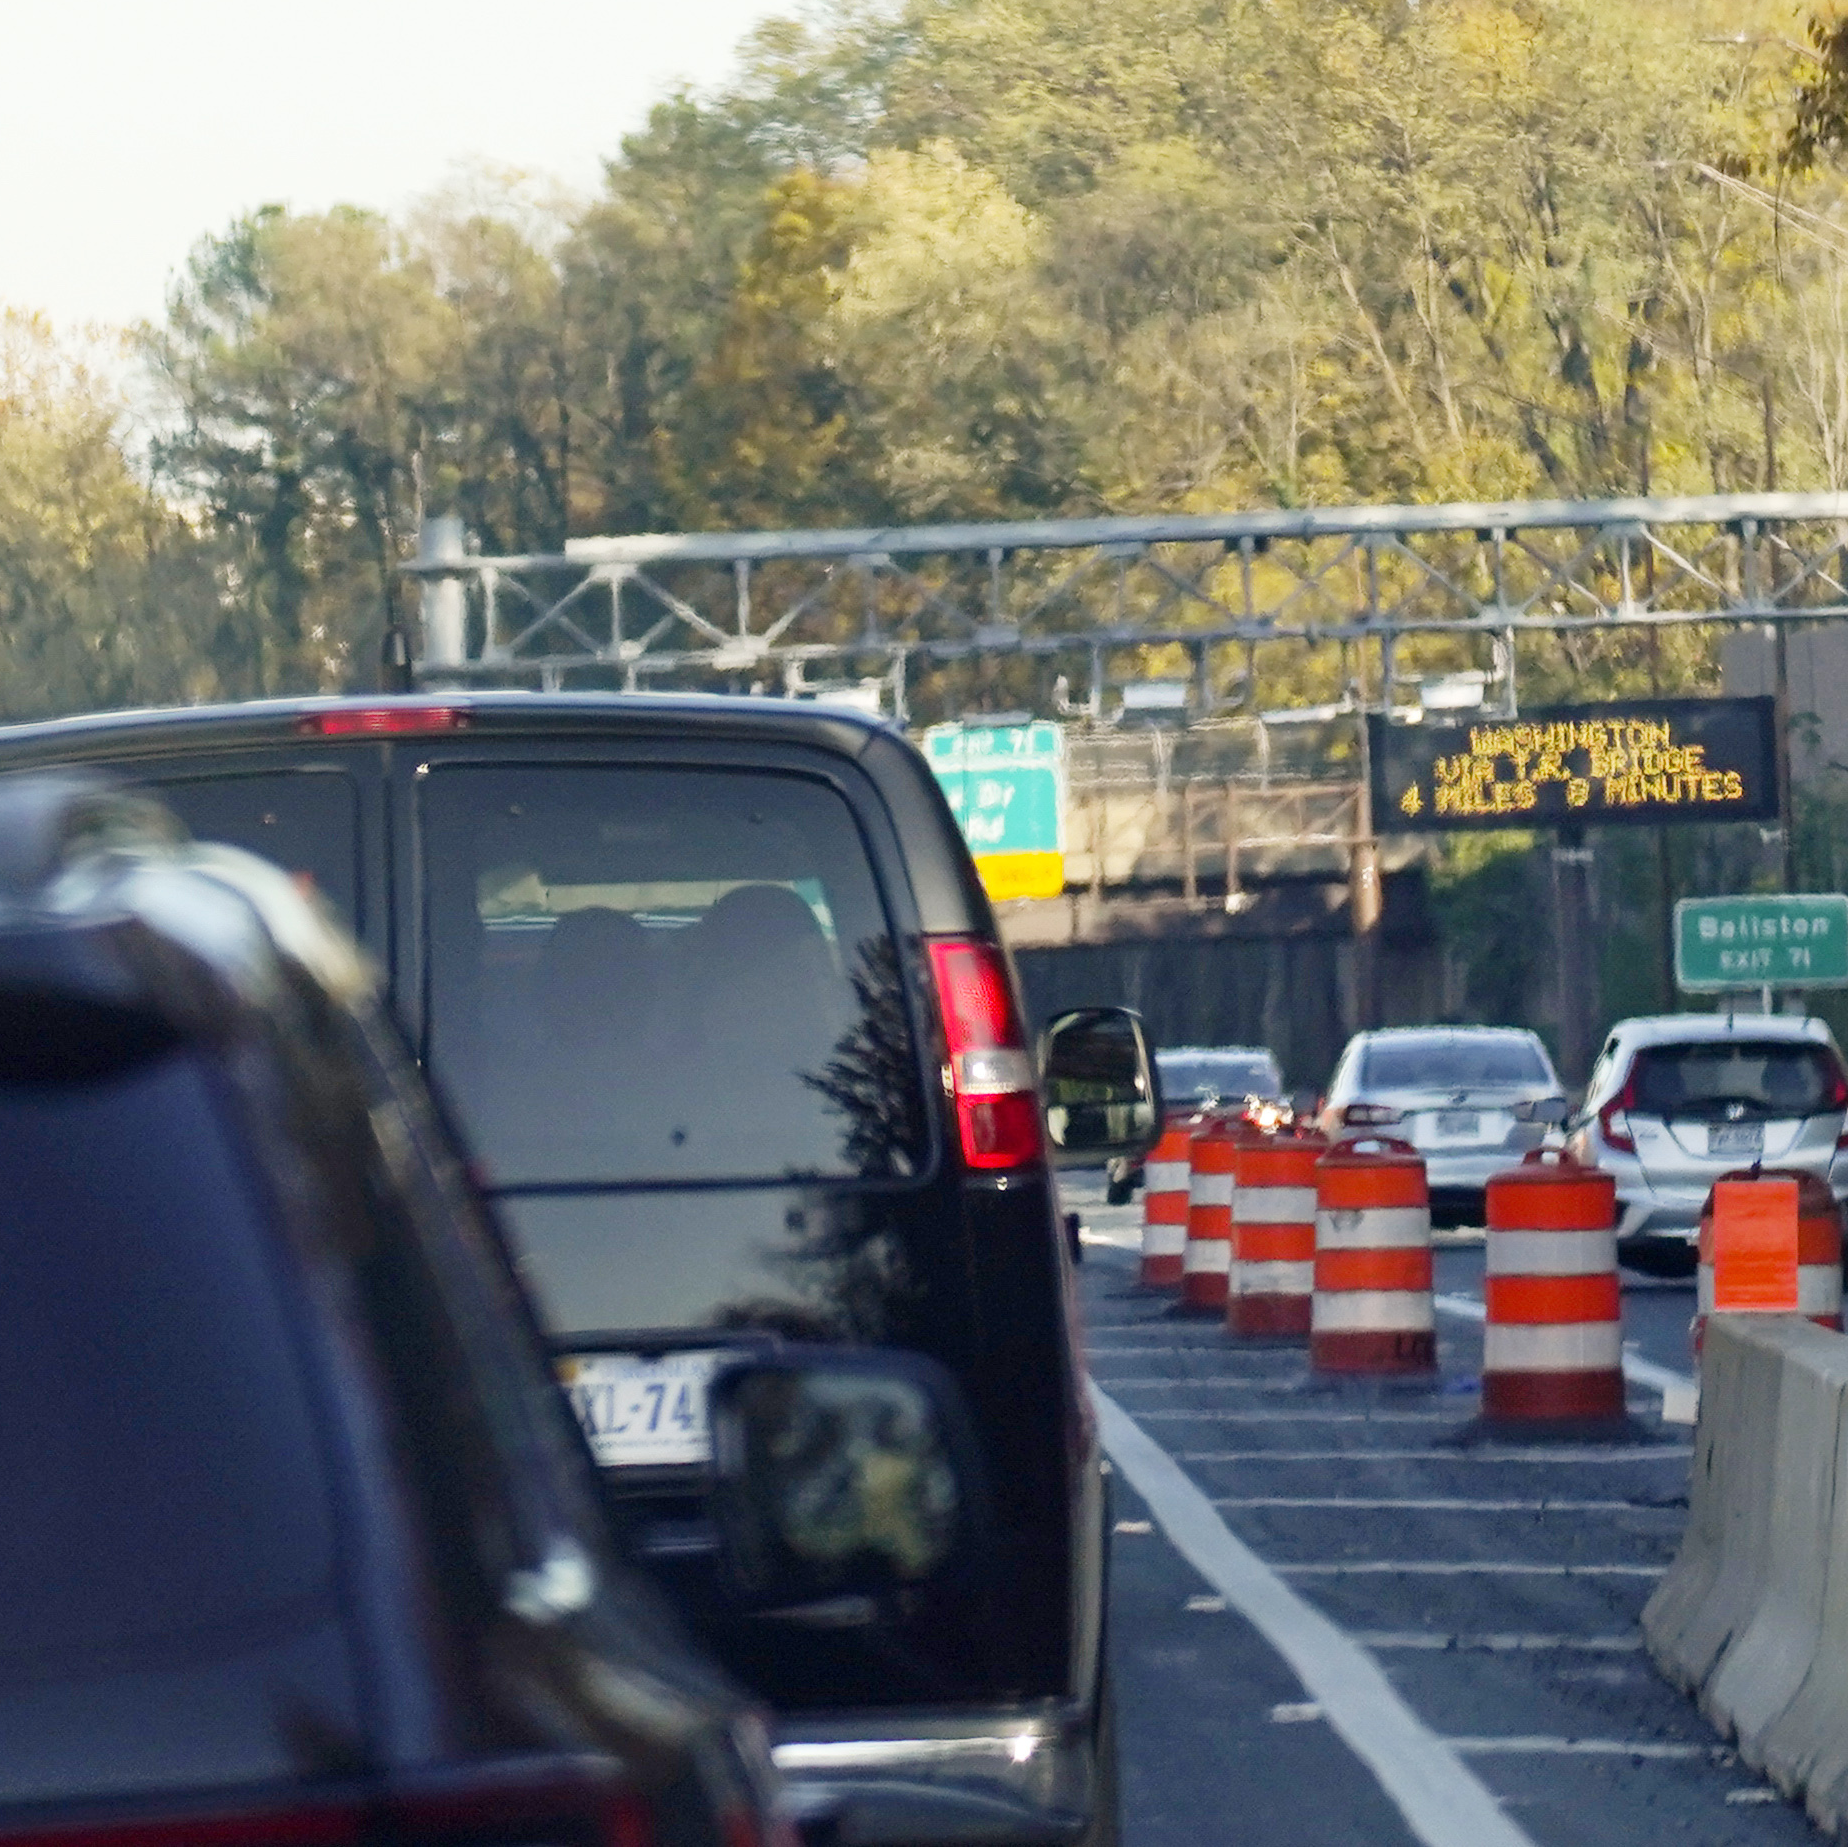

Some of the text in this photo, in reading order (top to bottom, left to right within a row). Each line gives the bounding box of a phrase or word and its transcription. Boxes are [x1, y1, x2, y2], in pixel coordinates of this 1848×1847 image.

[1470, 717, 1670, 755] WASHINGTON
[1434, 755, 1495, 783] VIA
[1590, 745, 1705, 778] BRIDGE
[1400, 781, 1424, 817] 4
[1434, 777, 1538, 815] MILES
[1604, 770, 1744, 806] MINUTES
[1698, 915, 1830, 939] Ballston
[1720, 947, 1811, 969] EXIT 71
